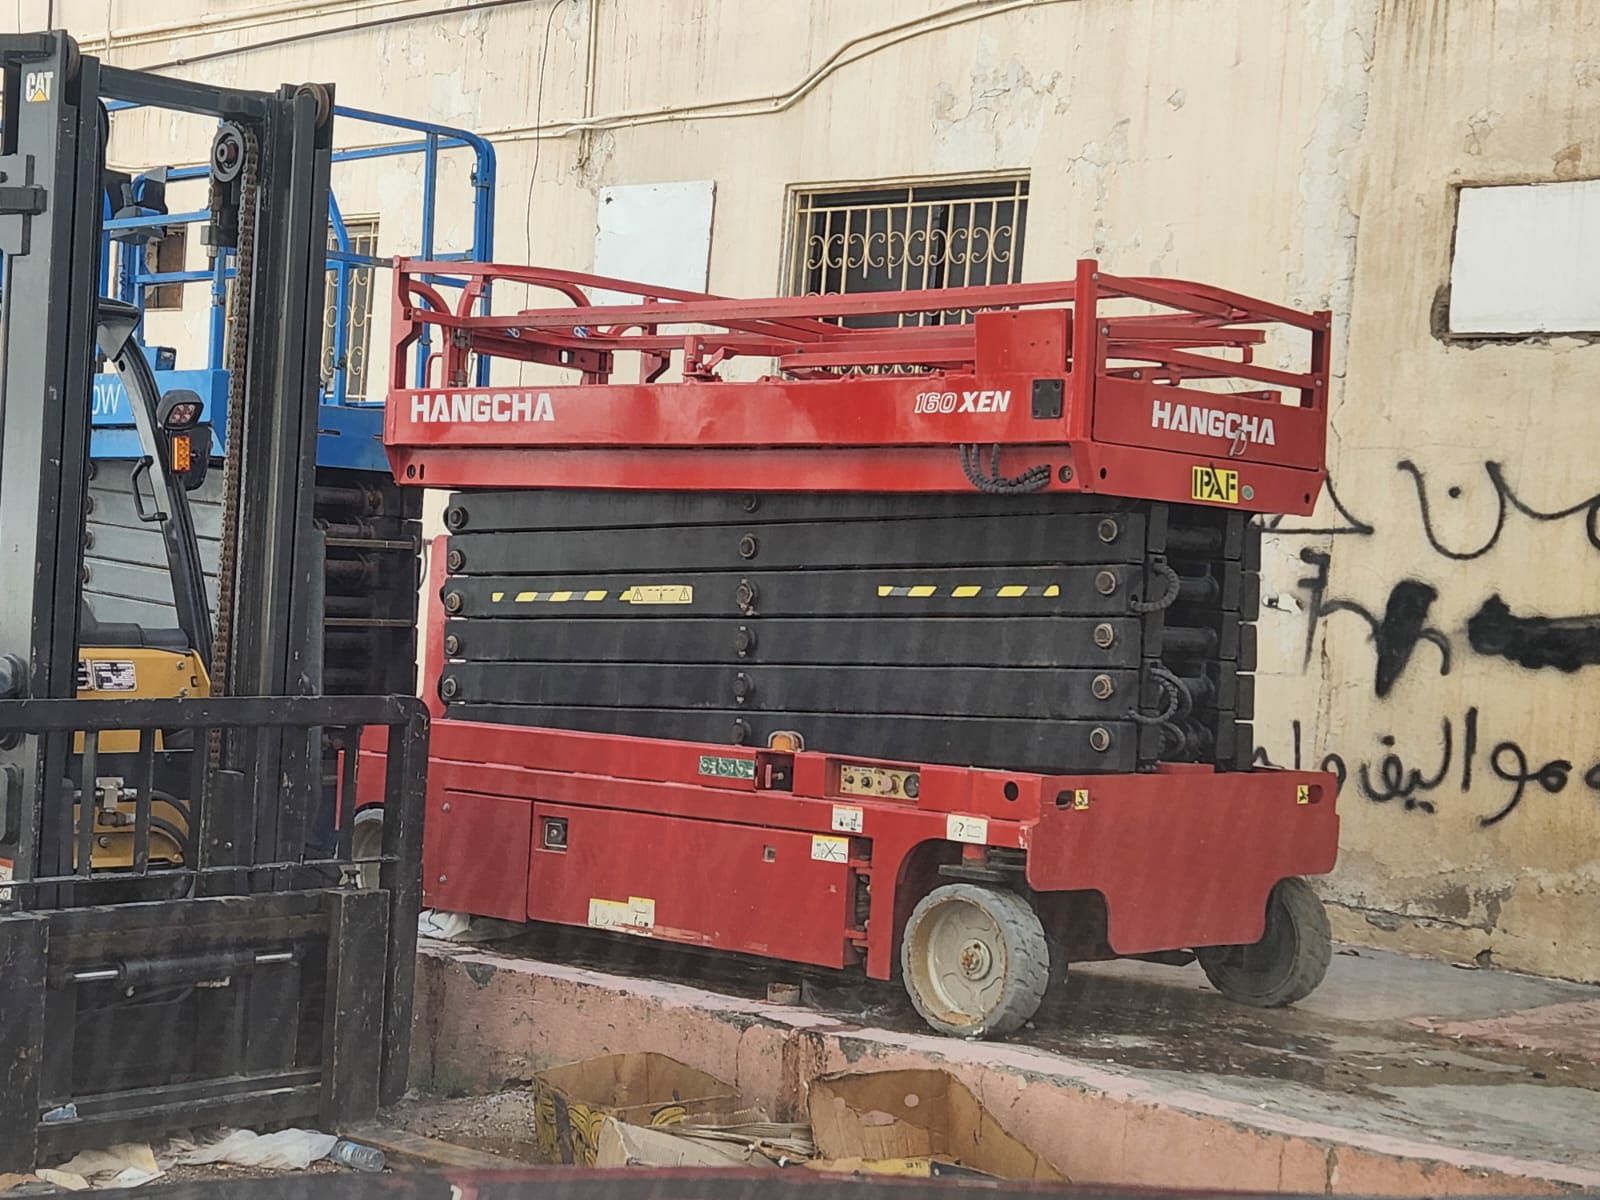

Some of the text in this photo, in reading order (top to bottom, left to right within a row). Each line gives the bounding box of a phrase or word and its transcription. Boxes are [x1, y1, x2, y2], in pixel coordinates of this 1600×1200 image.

[25, 71, 54, 102] CAT
[410, 393, 555, 423] HANGCHA
[914, 390, 1011, 413] 160 XEN
[1151, 399, 1276, 446] HANGCHA
[1193, 462, 1237, 501] IPAF
